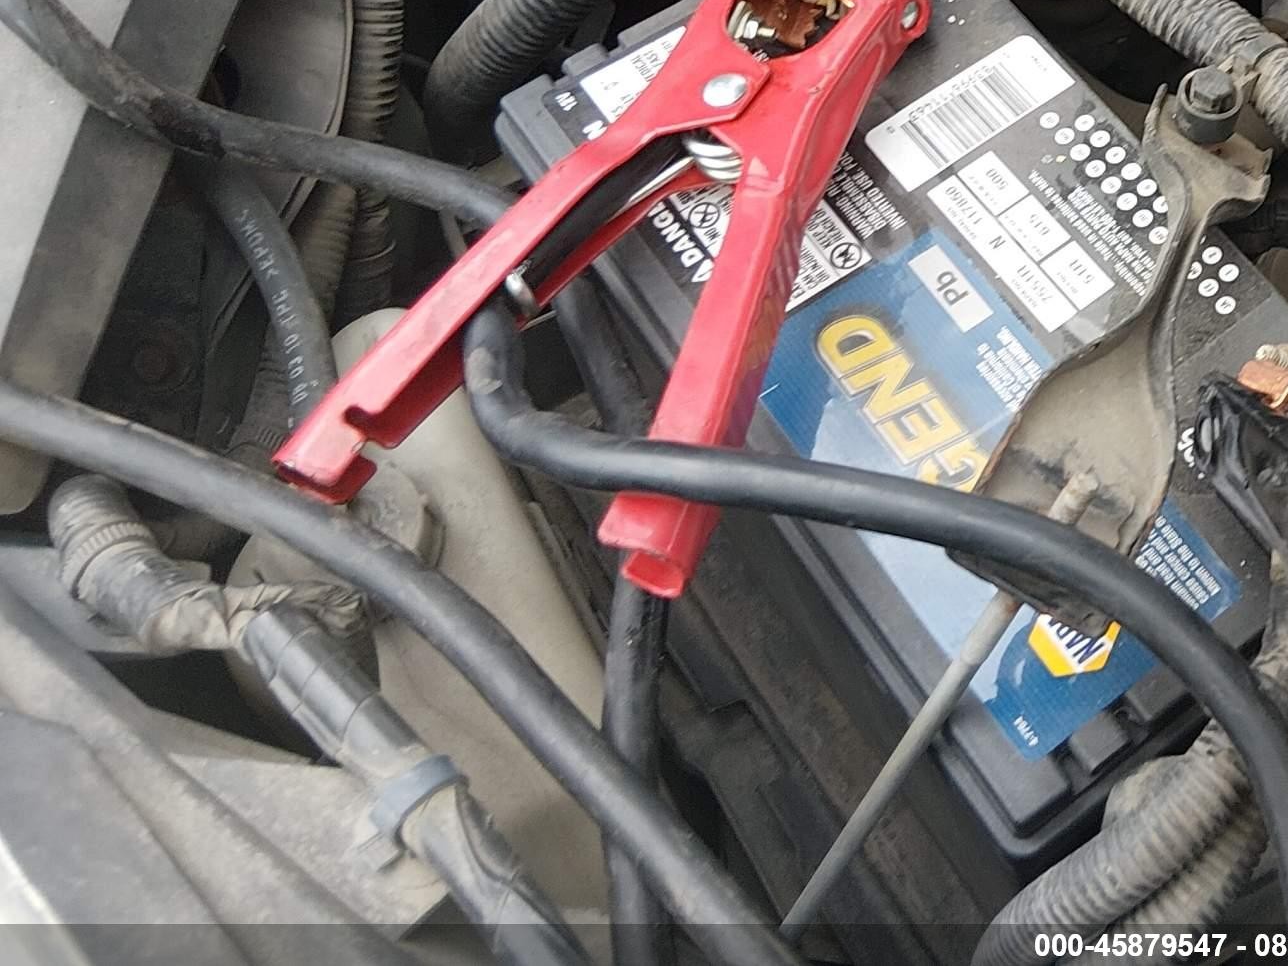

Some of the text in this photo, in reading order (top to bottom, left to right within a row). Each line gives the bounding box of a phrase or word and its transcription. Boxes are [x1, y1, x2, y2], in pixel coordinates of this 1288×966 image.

[987, 234, 1006, 249] N
[928, 268, 970, 307] Pb
[1161, 550, 1193, 581] cancer
[1191, 564, 1223, 596] known
[1046, 617, 1106, 664] NAP
